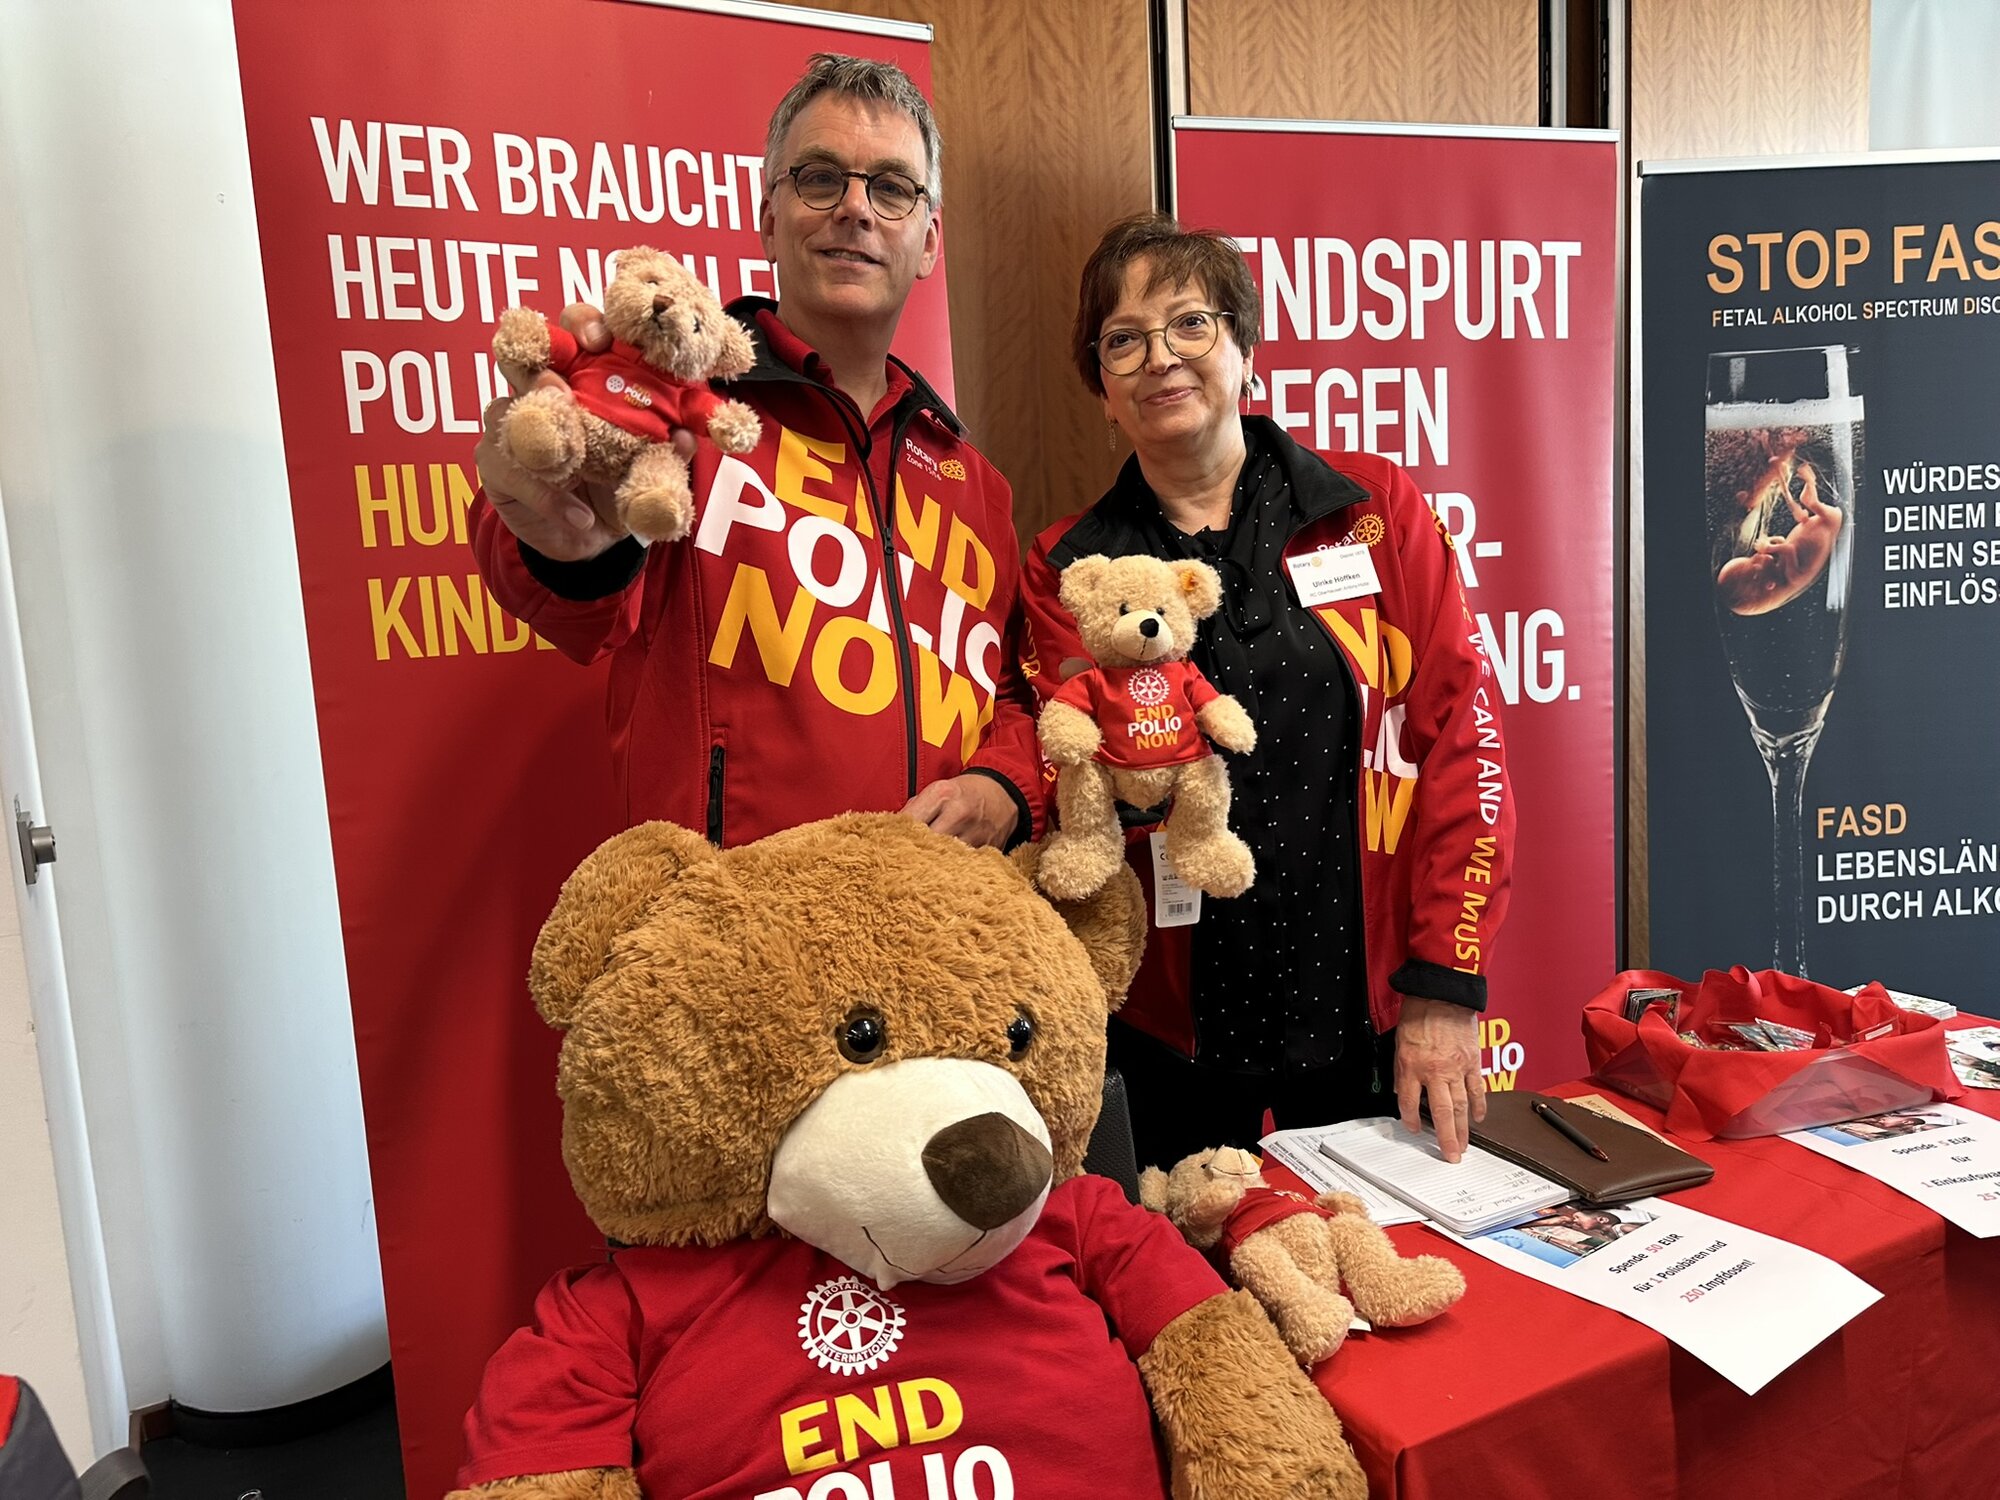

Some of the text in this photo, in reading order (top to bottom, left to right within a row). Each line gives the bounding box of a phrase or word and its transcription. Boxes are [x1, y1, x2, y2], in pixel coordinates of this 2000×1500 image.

[309, 116, 766, 232] WER BRAUCHT
[327, 234, 540, 323] HEUTE
[1706, 228, 1871, 294] STOP
[1712, 308, 1767, 327] FETAL
[1772, 303, 1858, 325] ALKOHOL
[1862, 297, 1958, 320] SPECTRUM
[340, 350, 510, 434] POLI
[624, 386, 652, 406] POLIO
[905, 438, 938, 472] Rotary
[775, 426, 996, 612] END
[1884, 502, 1986, 533] DEINEM
[1884, 541, 1963, 571] EINEN
[1312, 578, 1333, 588] Ulrike
[1884, 572, 2000, 609] EINFLÖS
[367, 574, 558, 661] KIND
[708, 562, 994, 767] NOW
[1468, 632, 1491, 678] WE
[1127, 716, 1182, 738] POLIO
[1134, 704, 1175, 722] END
[1473, 687, 1501, 749] CAN
[1135, 731, 1179, 750] NOW
[1476, 757, 1503, 826] AND
[1817, 803, 1907, 839] FASD
[1464, 836, 1497, 885] WE
[1817, 890, 1923, 924] DURCH
[1891, 1143, 1938, 1155] Spende
[1948, 1136, 1976, 1145] EUR
[1951, 1155, 1972, 1163] für
[1609, 1232, 1684, 1274] Spende 50 EUR
[1633, 1239, 1727, 1293] für 1 Poliobären und
[823, 1282, 868, 1297] ROTARY
[1680, 1258, 1755, 1303] 250 Impfdosen!
[818, 1325, 894, 1364] INTERNATIONAL
[780, 1377, 963, 1476] END
